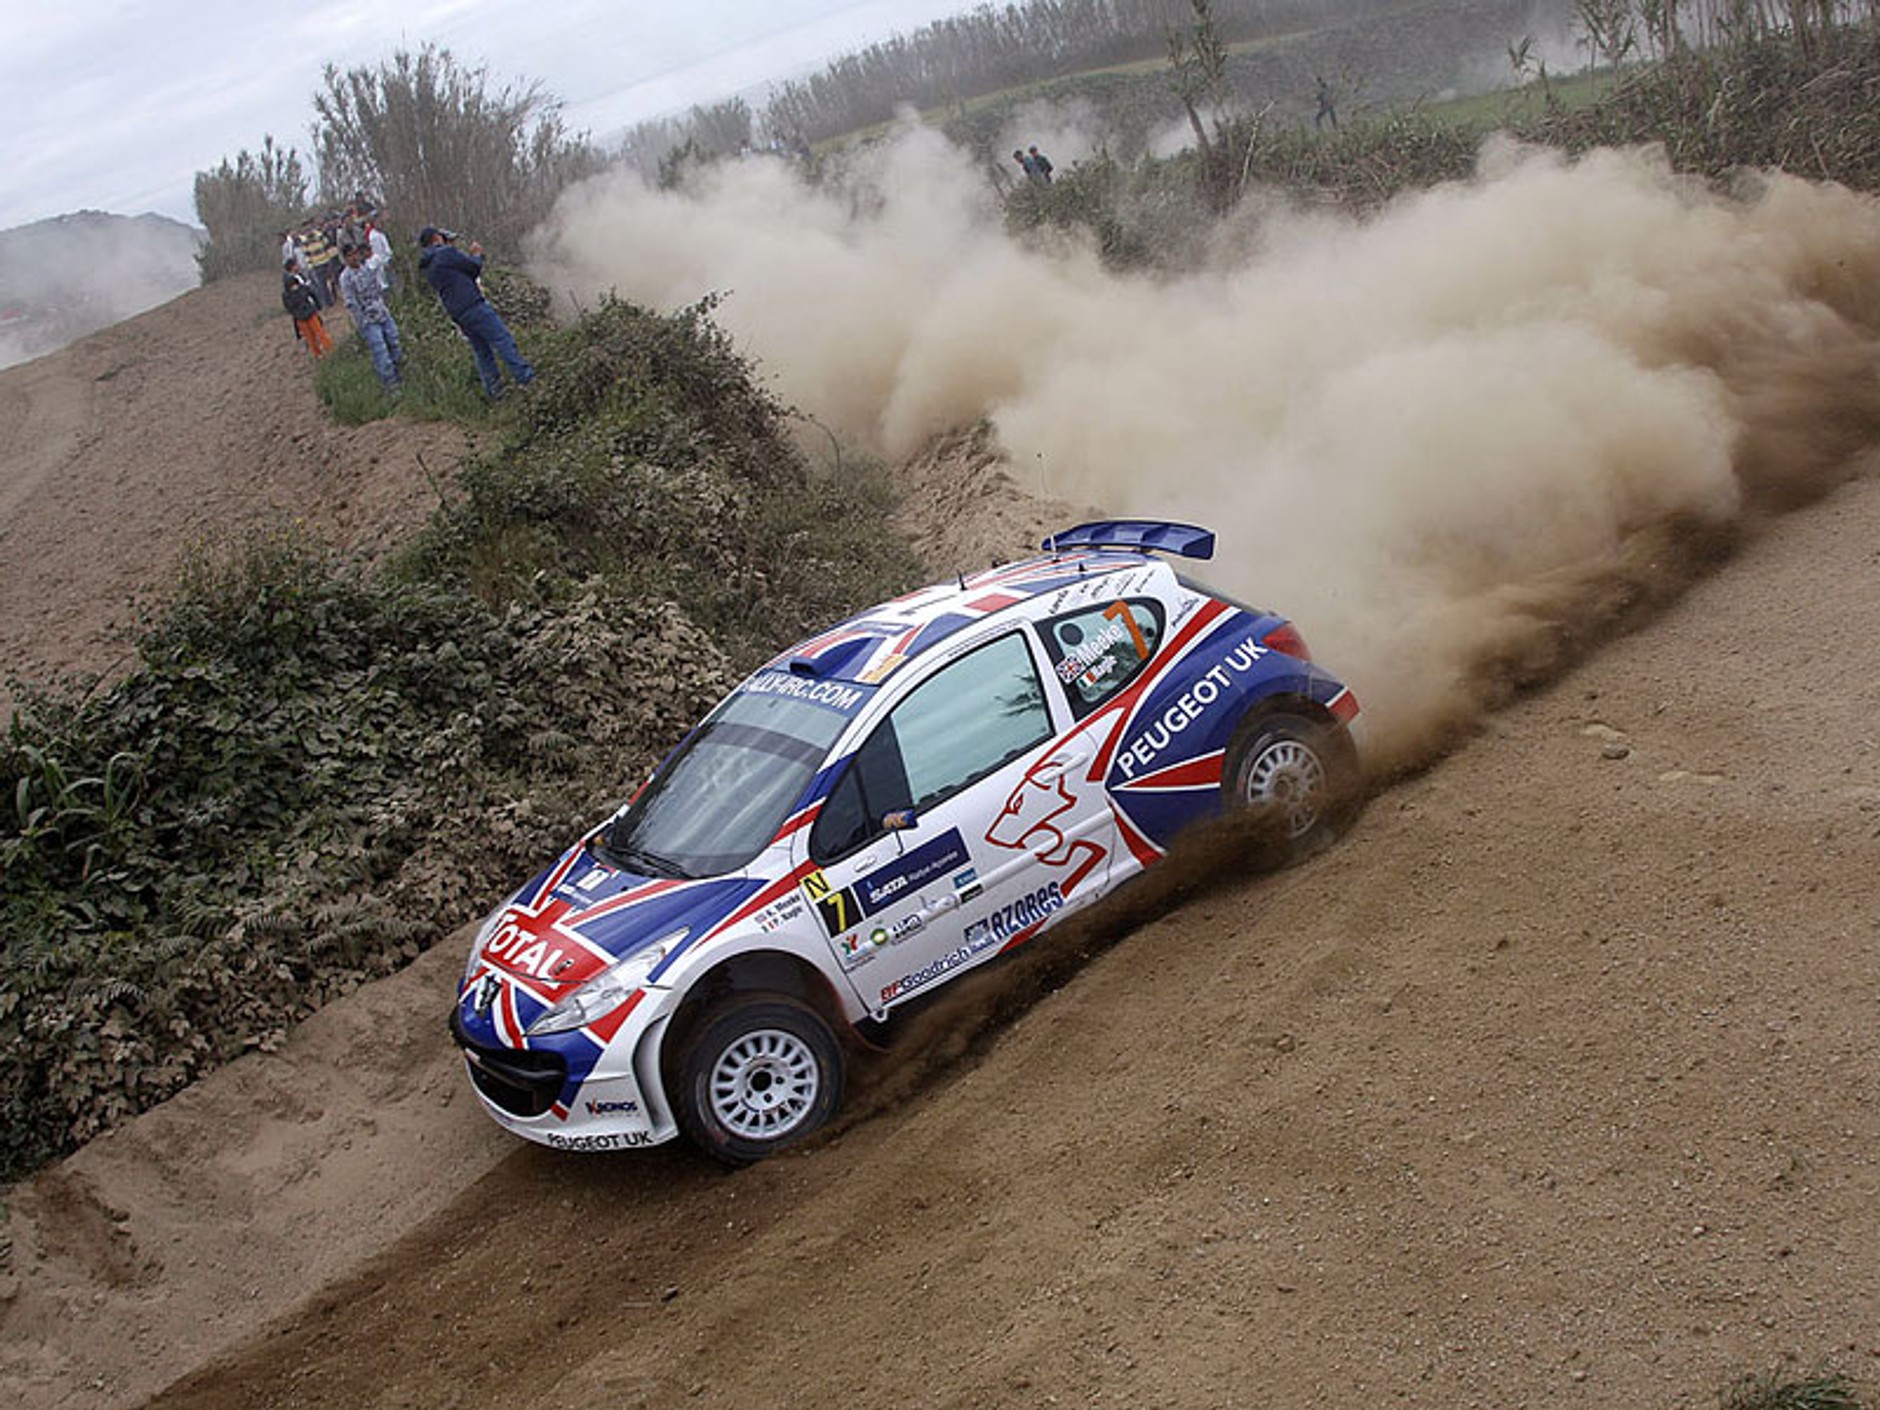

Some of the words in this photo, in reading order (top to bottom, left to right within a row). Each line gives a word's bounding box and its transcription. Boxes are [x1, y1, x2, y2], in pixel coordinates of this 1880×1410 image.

[1102, 600, 1149, 660] 7
[1117, 665, 1231, 779] PEUGEOT
[1224, 636, 1268, 671] UK
[803, 872, 831, 900] N
[827, 893, 846, 933] 7
[487, 912, 563, 990] TOTAL
[881, 948, 969, 1000] BFGoodrich
[547, 1133, 620, 1151] PEUGEOT
[623, 1131, 654, 1147] UK
